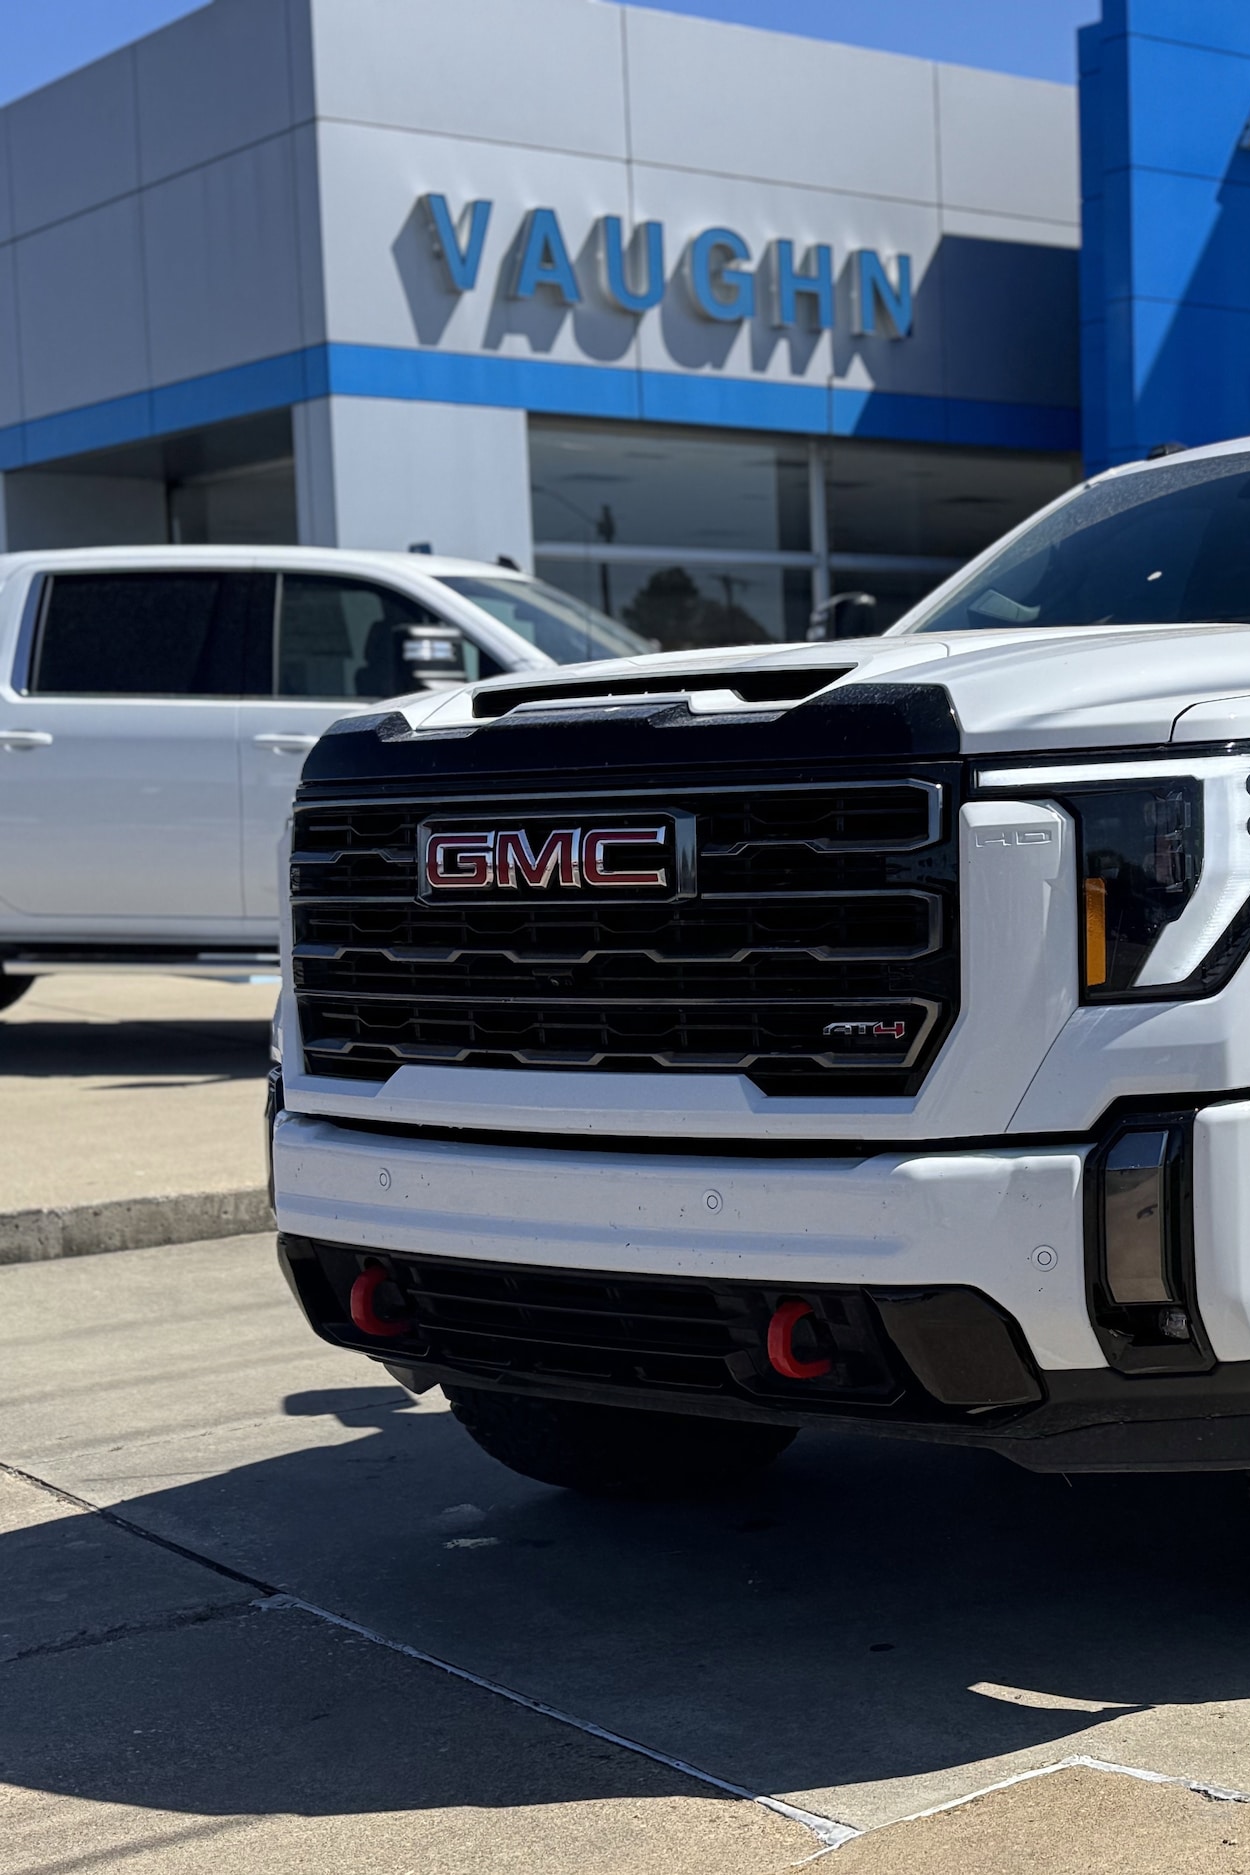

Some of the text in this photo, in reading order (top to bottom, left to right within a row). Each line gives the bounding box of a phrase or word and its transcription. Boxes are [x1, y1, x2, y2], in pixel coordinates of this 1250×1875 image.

[420, 192, 914, 337] VAUGHN
[426, 826, 667, 889] GMC
[975, 831, 1053, 848] HD
[823, 1021, 905, 1039] AT4
